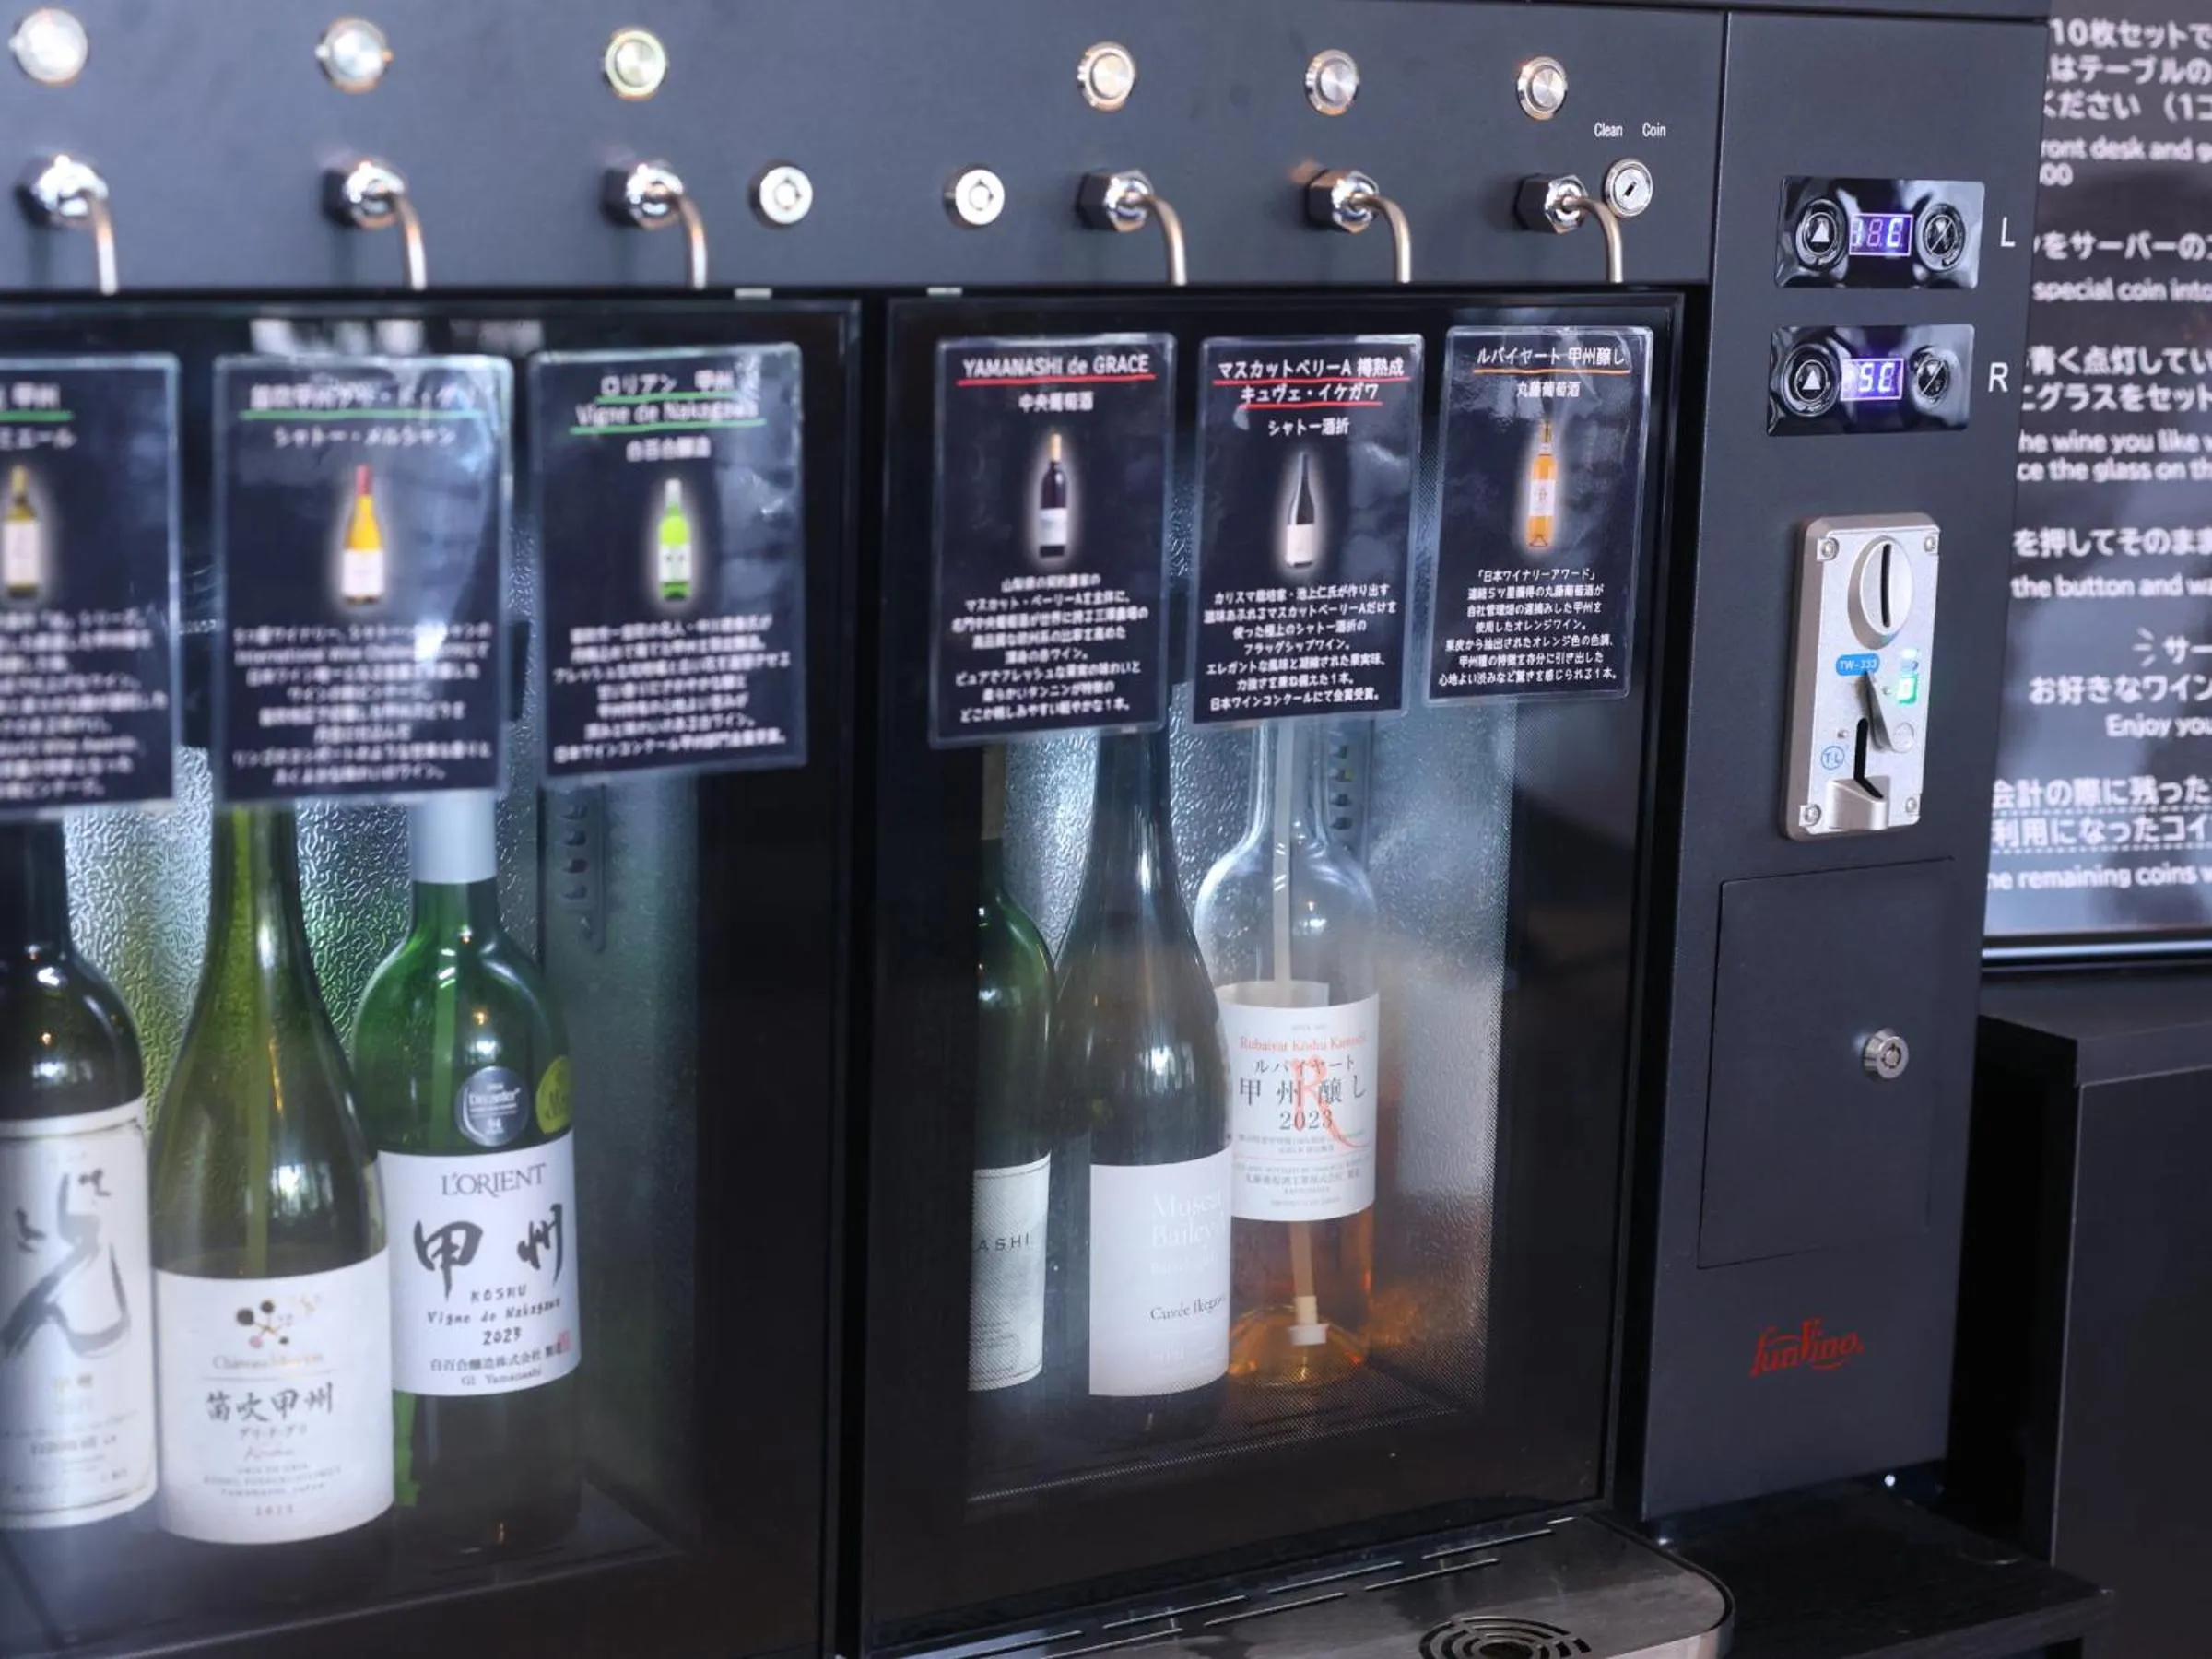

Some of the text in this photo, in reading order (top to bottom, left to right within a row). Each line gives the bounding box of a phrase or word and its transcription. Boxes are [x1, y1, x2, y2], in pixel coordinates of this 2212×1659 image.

[1594, 121, 1624, 137] Clean
[1642, 121, 1666, 137] Coin
[2089, 135, 2147, 160] desk
[2148, 136, 2194, 161] and
[2000, 216, 2017, 247] L
[2032, 276, 2115, 302] special
[2117, 276, 2168, 302] coin
[962, 354, 1149, 377] YAMANASHI de GRACE
[1477, 347, 1560, 364] ルバイヤート
[1989, 362, 2009, 393] R
[2051, 429, 2108, 453] wine
[2110, 433, 2155, 454] you
[2157, 428, 2201, 453] like
[2047, 457, 2089, 481] the
[2092, 456, 2153, 482] glass
[2155, 462, 2187, 480] on
[2010, 574, 2053, 598] the
[2054, 573, 2136, 598] button
[2138, 572, 2183, 597] and
[2029, 674, 2212, 705] お好きなワイン
[2105, 713, 2172, 737] Enjoy
[2017, 864, 2132, 888] remaining
[2135, 862, 2198, 886] coins
[427, 1309, 471, 1326] Vigne
